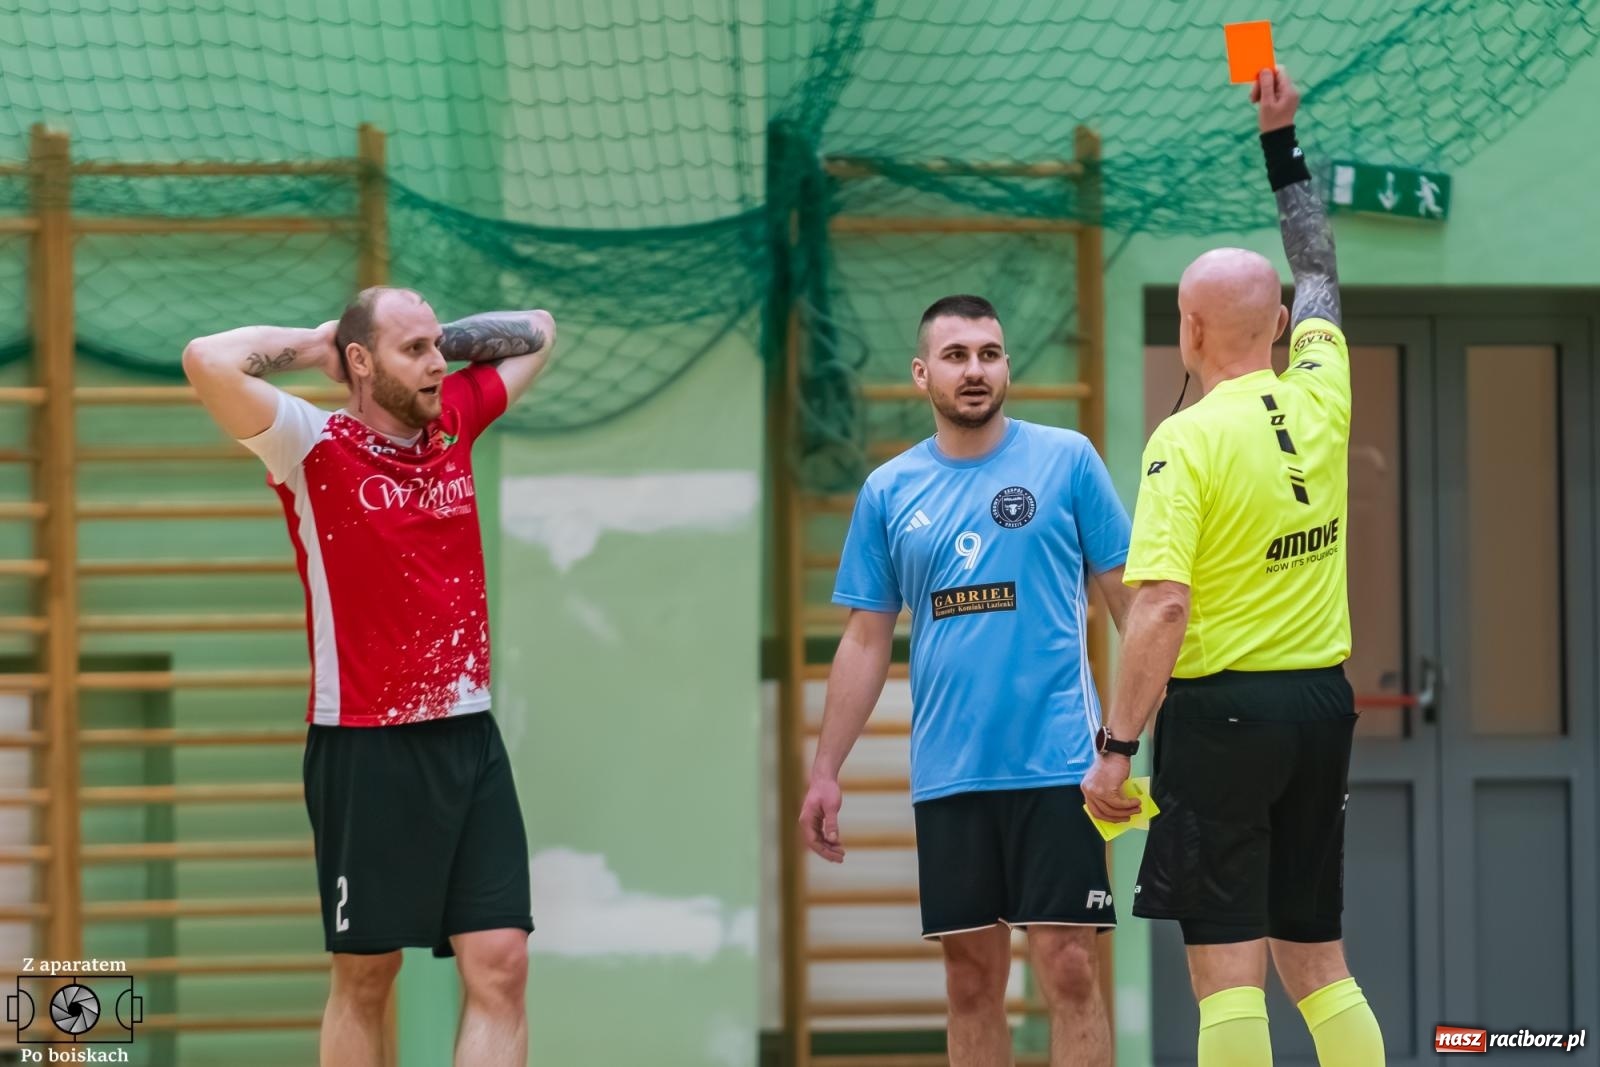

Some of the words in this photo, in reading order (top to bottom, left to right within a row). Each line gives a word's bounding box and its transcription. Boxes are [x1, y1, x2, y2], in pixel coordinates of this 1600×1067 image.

[954, 530, 982, 570] 9
[1266, 517, 1339, 561] 4MOVE
[1265, 562, 1289, 574] NOW
[934, 587, 1014, 607] GABRIEL
[336, 875, 350, 932] 2
